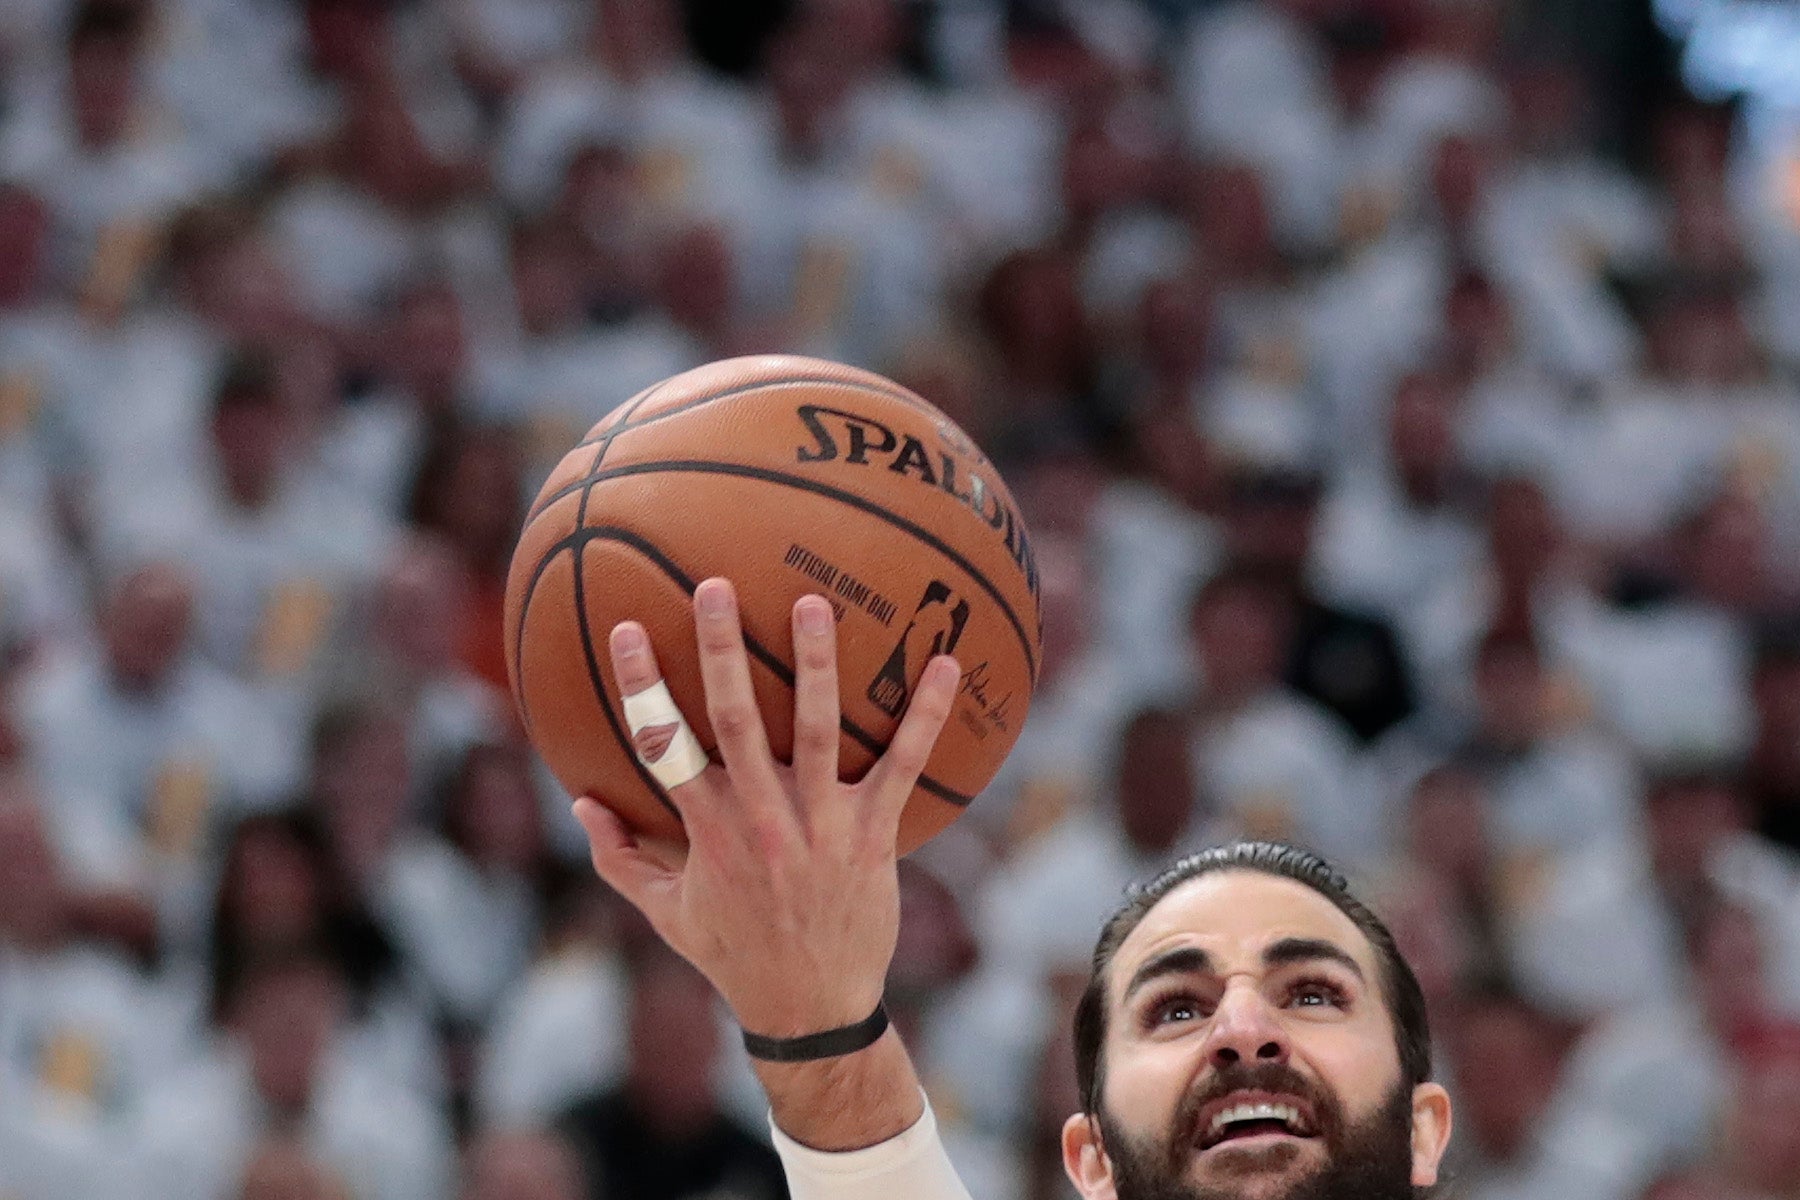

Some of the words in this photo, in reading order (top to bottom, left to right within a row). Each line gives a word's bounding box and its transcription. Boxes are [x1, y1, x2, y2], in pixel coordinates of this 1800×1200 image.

[797, 405, 1041, 606] SPALDIN
[784, 543, 839, 589] OFFICIAL
[835, 573, 872, 607] GAME
[867, 593, 899, 627] BALL
